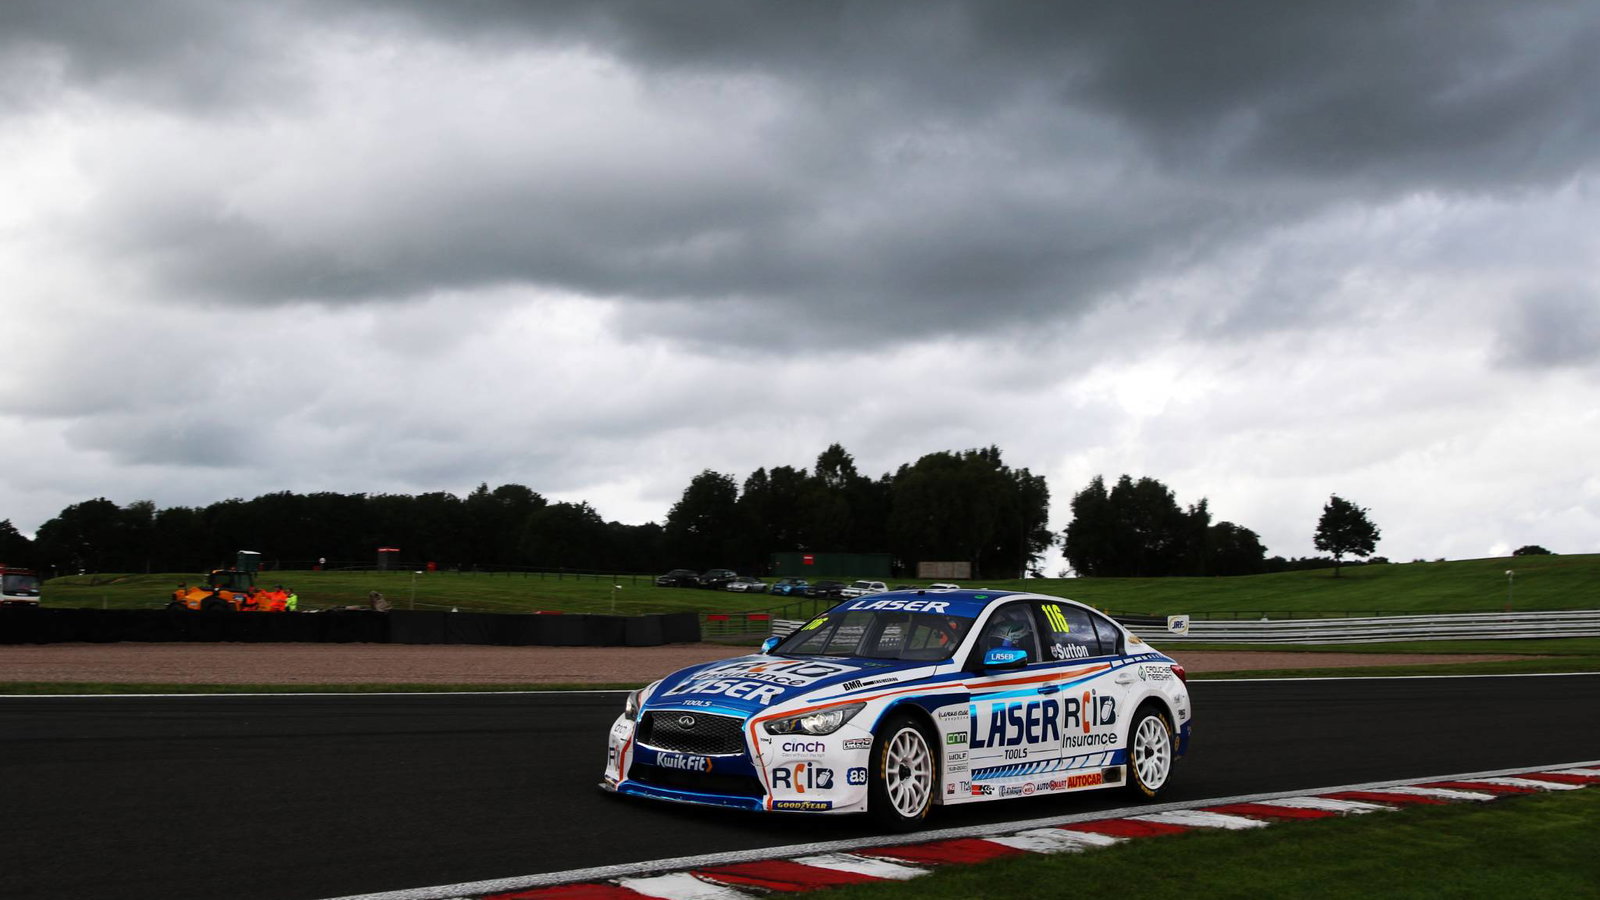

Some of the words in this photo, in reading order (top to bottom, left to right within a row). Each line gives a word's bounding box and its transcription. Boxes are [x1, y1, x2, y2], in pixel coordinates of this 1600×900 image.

[848, 600, 950, 614] LASER
[1041, 604, 1070, 633] 116
[1056, 643, 1089, 659] Sutton
[661, 679, 786, 706] LASER
[842, 680, 863, 691] BMR
[682, 699, 712, 707] TOOLS
[969, 699, 1060, 749] LASER
[782, 741, 826, 753] cinch
[1062, 732, 1118, 749] Insurance
[1004, 748, 1028, 760] TOOLS
[1067, 773, 1102, 789] AUTOCAR
[777, 802, 828, 810] GOODYEAR
